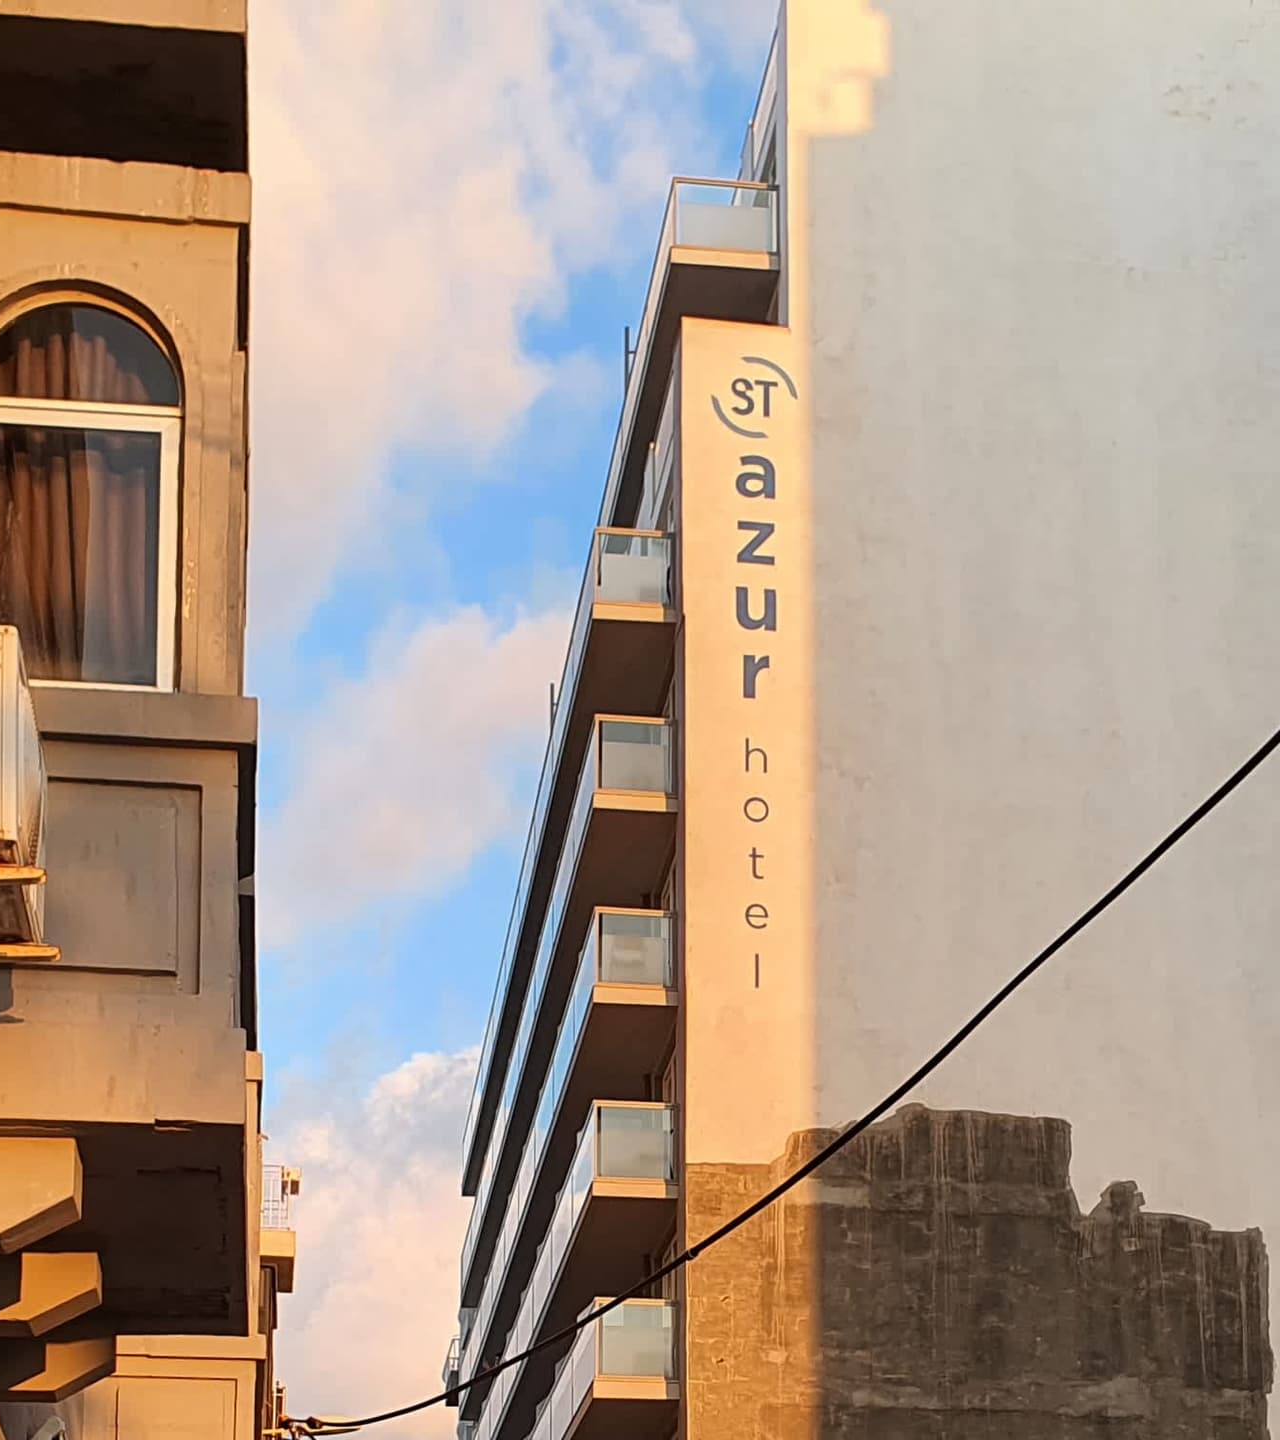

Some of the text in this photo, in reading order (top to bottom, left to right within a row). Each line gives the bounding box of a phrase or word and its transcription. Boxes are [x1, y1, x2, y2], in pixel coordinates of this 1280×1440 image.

[731, 377, 779, 418] ST
[735, 455, 777, 989] azur hotel
